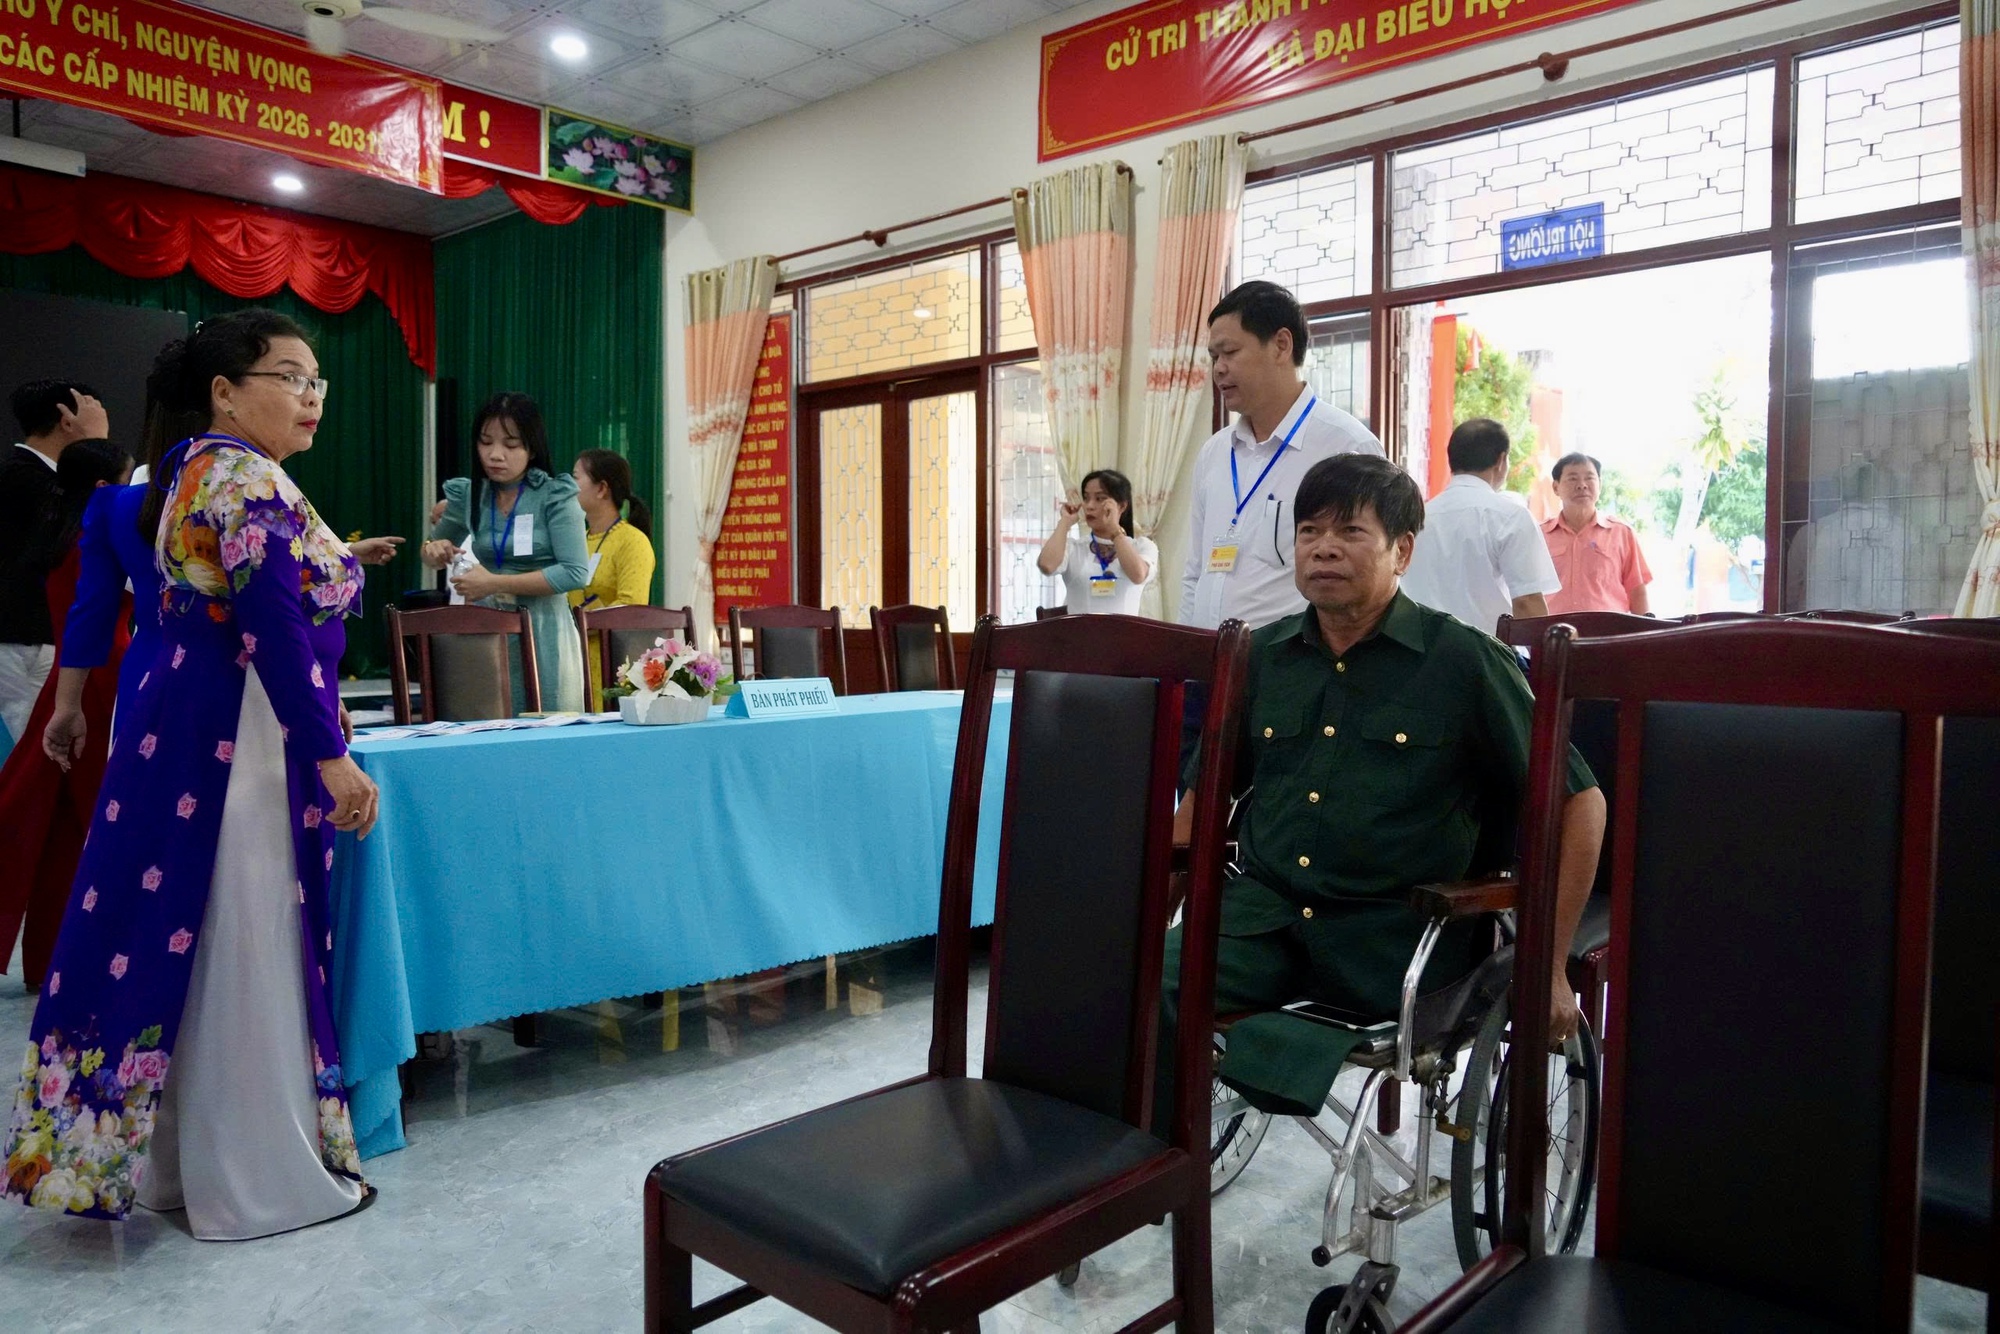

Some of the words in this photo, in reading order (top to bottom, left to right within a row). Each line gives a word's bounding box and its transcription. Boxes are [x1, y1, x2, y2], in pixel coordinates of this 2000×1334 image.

[72, 4, 127, 50] CHÍ,
[136, 21, 239, 77] NGUYỆN
[247, 52, 311, 94] VỌNG
[1106, 26, 1141, 71] CỬ
[1147, 19, 1187, 58] TRI
[1266, 29, 1305, 71] VÀ
[1314, 17, 1366, 63] ĐẠI
[0, 32, 55, 76] CÁC
[63, 47, 119, 90] CẤP
[127, 68, 209, 117] NHIỆM
[217, 88, 250, 124] KỲ
[257, 102, 310, 139] 2026
[751, 689, 772, 709] BÀN
[773, 688, 798, 707] PHÁT
[799, 685, 829, 706] PHIẾU
